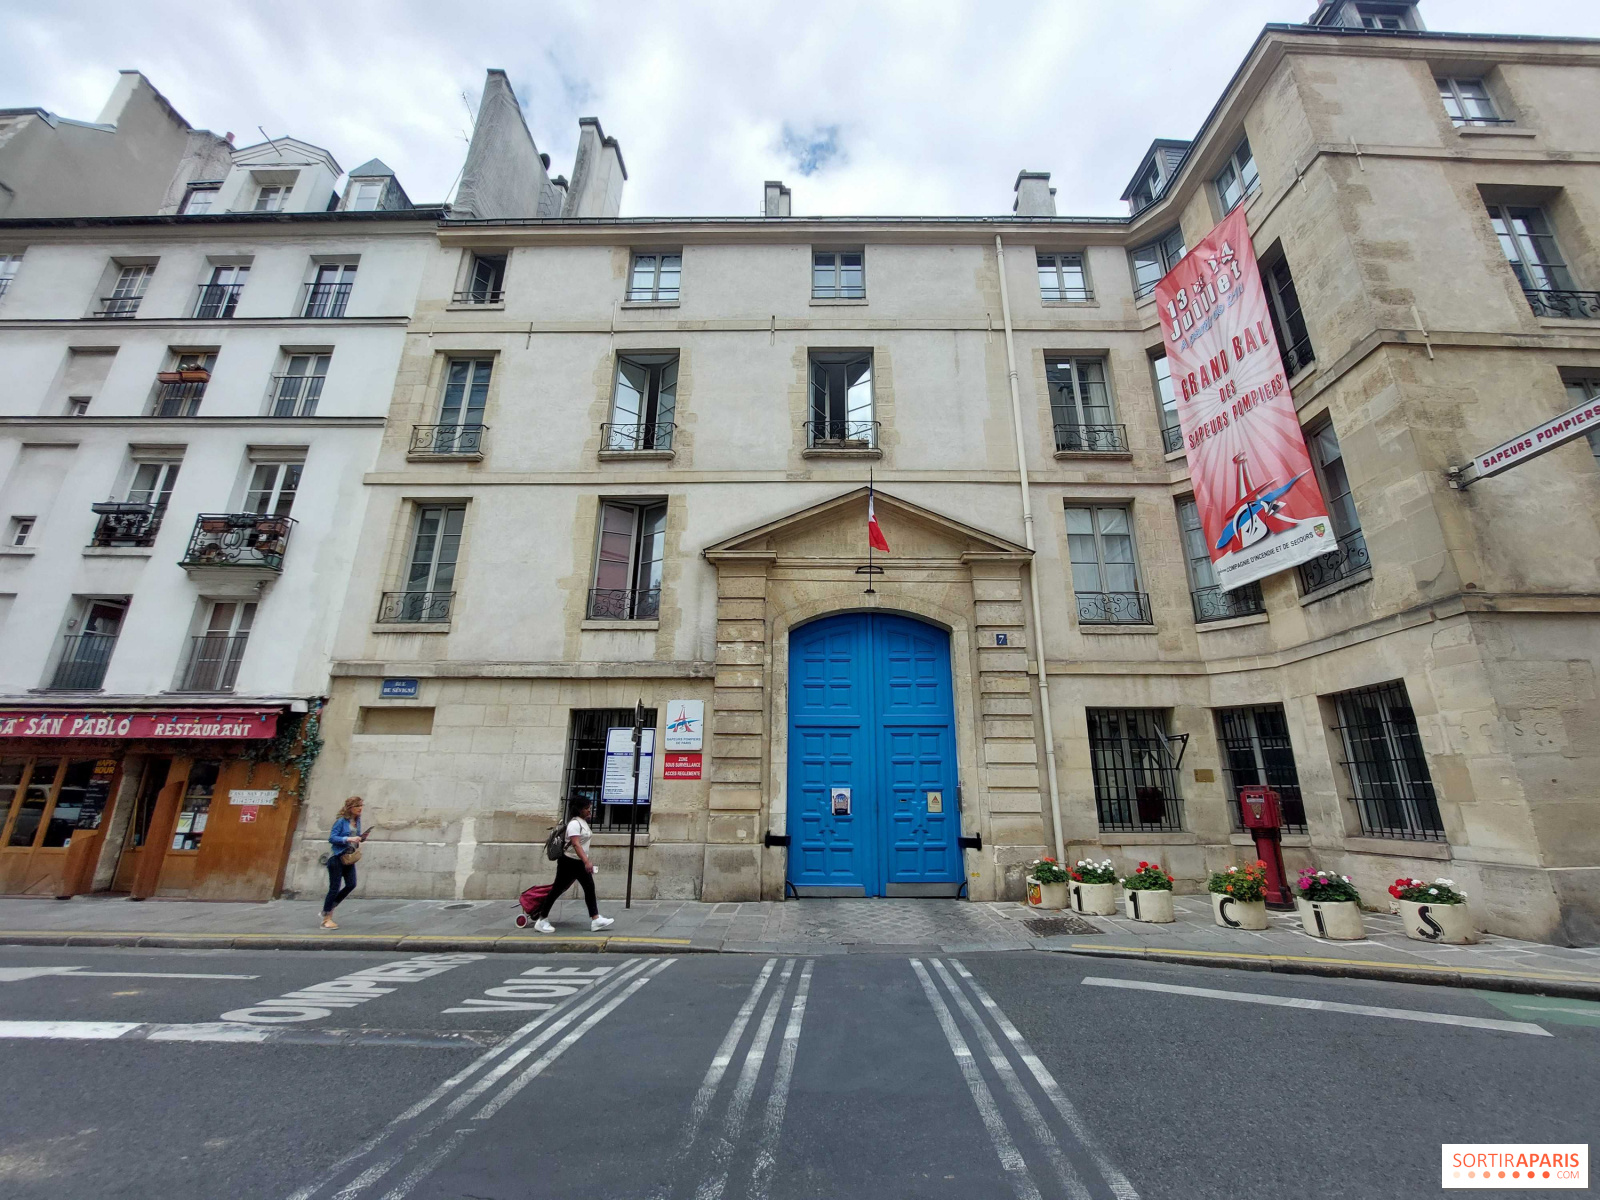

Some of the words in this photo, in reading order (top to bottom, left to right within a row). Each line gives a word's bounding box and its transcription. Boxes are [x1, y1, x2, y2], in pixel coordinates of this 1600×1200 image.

[1167, 288, 1188, 318] 13
[1171, 260, 1241, 341] Juillet
[1181, 349, 1230, 402] GRAND
[1231, 320, 1269, 362] BAL
[1188, 411, 1229, 450] SAPEURS
[1231, 374, 1284, 421] POMPIERS
[1219, 379, 1237, 403] DES
[1482, 438, 1533, 468] SAPEURS
[1536, 404, 1600, 443] POMPIERS
[1226, 559, 1251, 573] COMPAGNIE
[1251, 550, 1275, 563] D'INCENDIE
[1276, 545, 1283, 553] ET
[1283, 542, 1290, 550] DE
[1291, 532, 1313, 546] SECOURS
[998, 635, 1004, 643] 7
[24, 718, 63, 736] SAN
[69, 718, 131, 736] PABLO
[154, 723, 251, 737] RESTAURANT
[94, 766, 115, 774] HOUR
[1219, 897, 1243, 928] C
[1416, 905, 1446, 940] S
[440, 966, 615, 1014] VOIE
